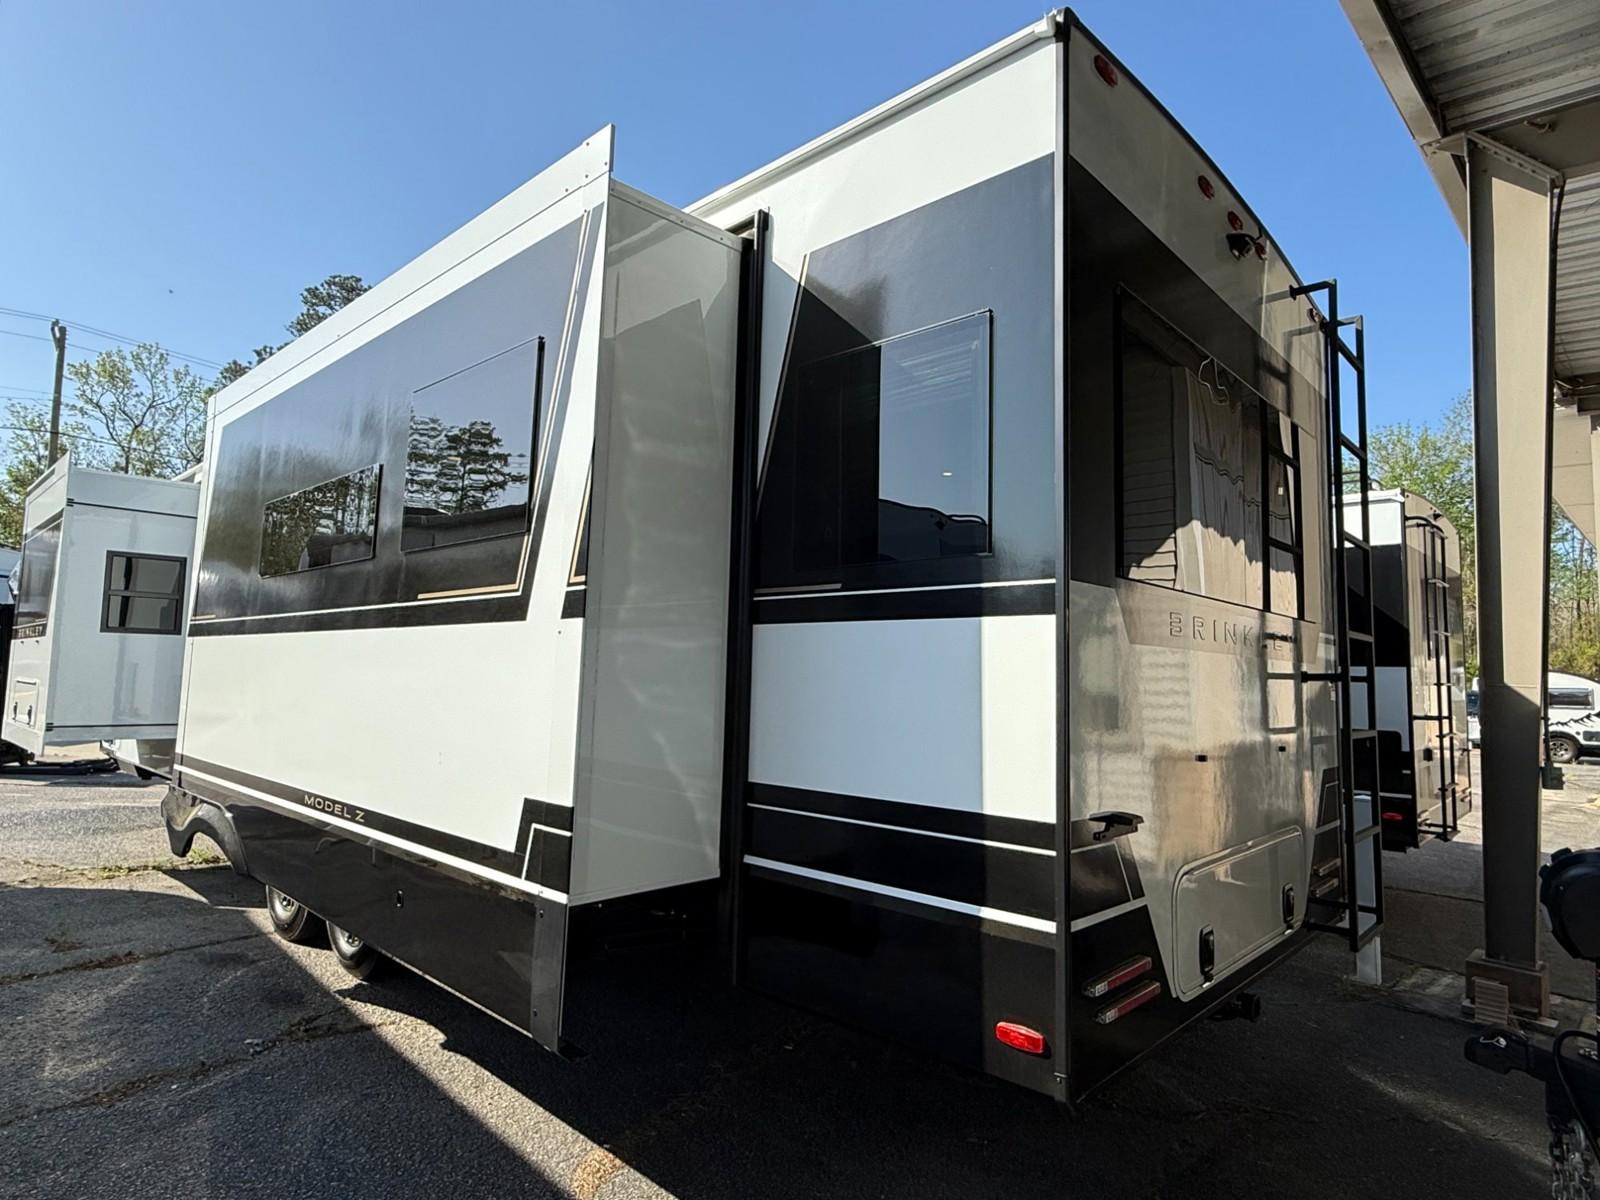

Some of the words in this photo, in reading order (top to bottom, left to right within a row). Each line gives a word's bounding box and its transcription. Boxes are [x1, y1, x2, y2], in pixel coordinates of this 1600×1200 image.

[1168, 611, 1296, 652] BRINKE
[304, 794, 352, 818] MODEL
[354, 810, 366, 823] Z
